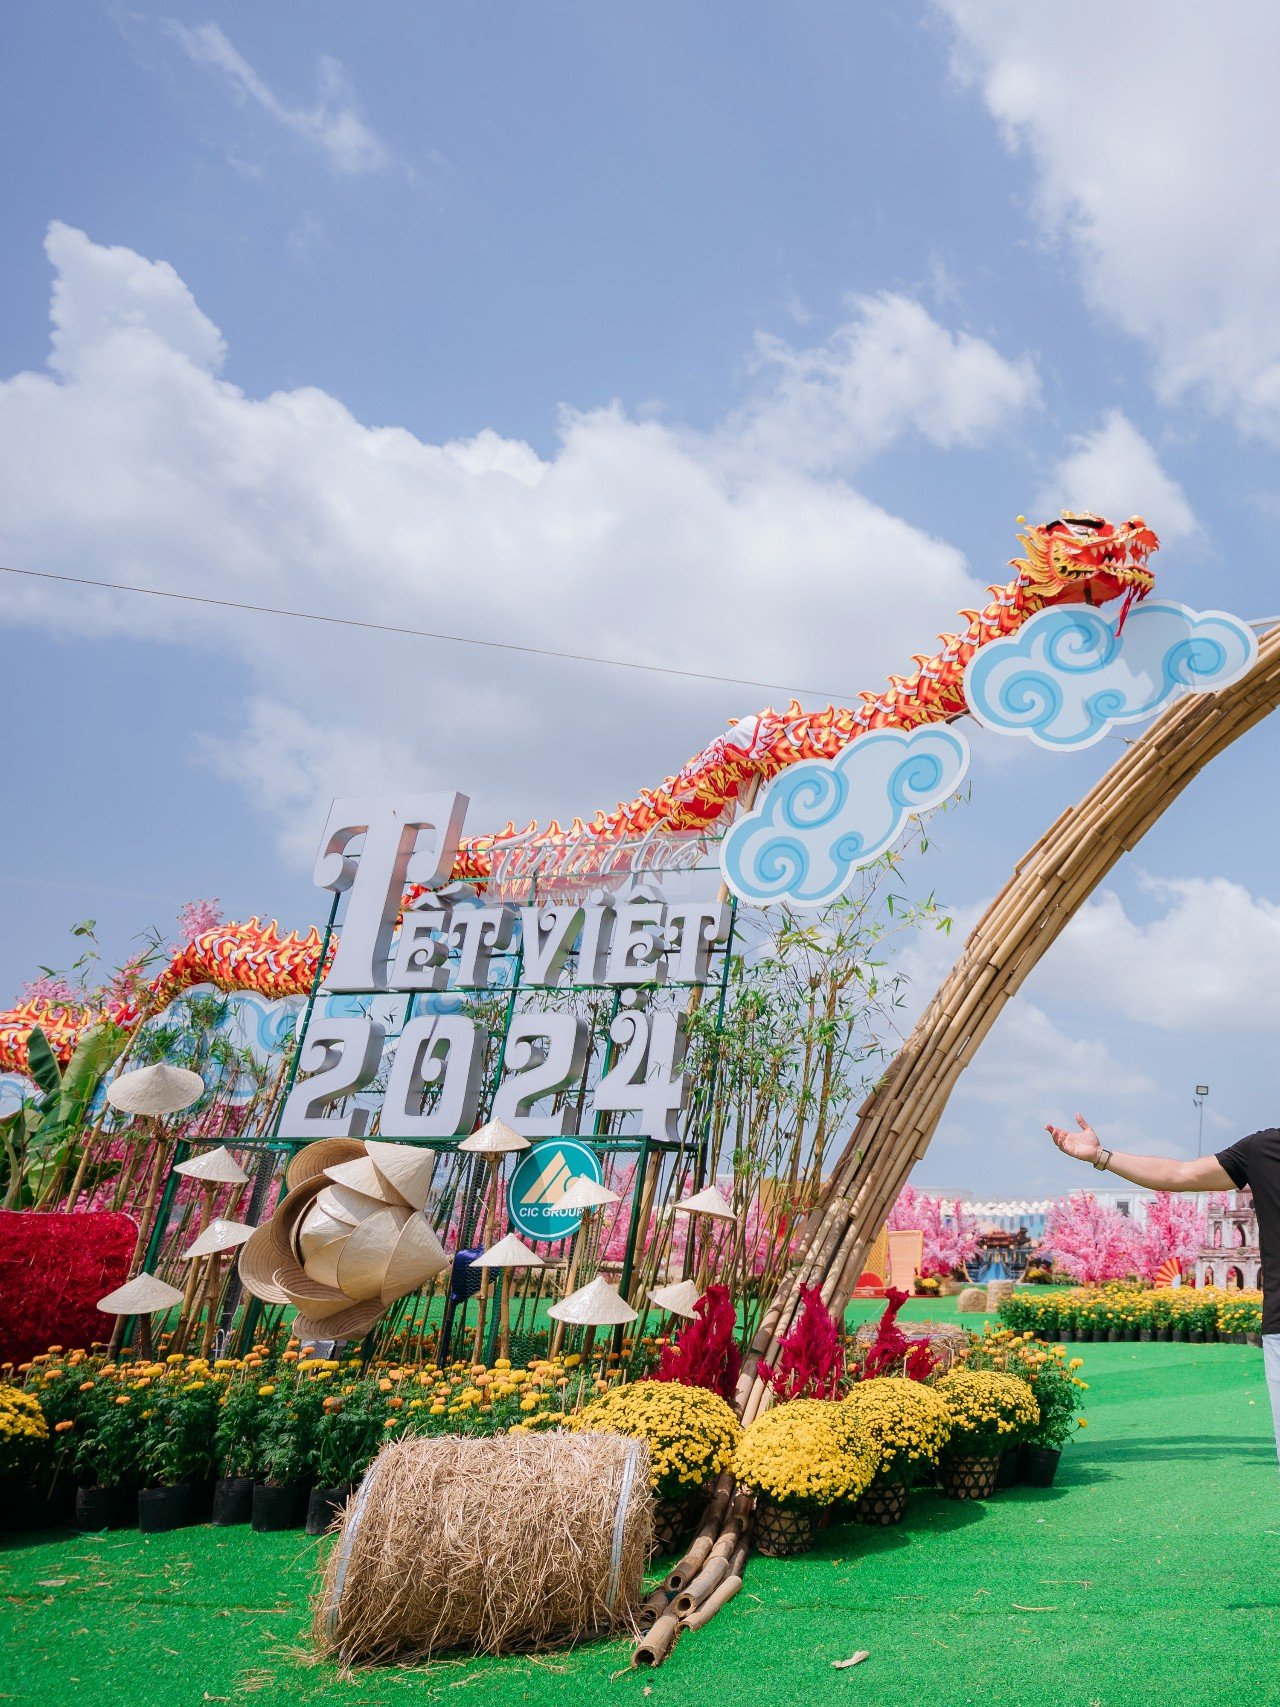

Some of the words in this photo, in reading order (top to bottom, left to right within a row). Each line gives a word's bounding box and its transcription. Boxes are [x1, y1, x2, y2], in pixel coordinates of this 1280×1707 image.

[485, 829, 602, 885] Tinh
[601, 816, 704, 876] Hoa
[276, 1010, 694, 1143] 2024
[519, 1207, 539, 1218] CIC
